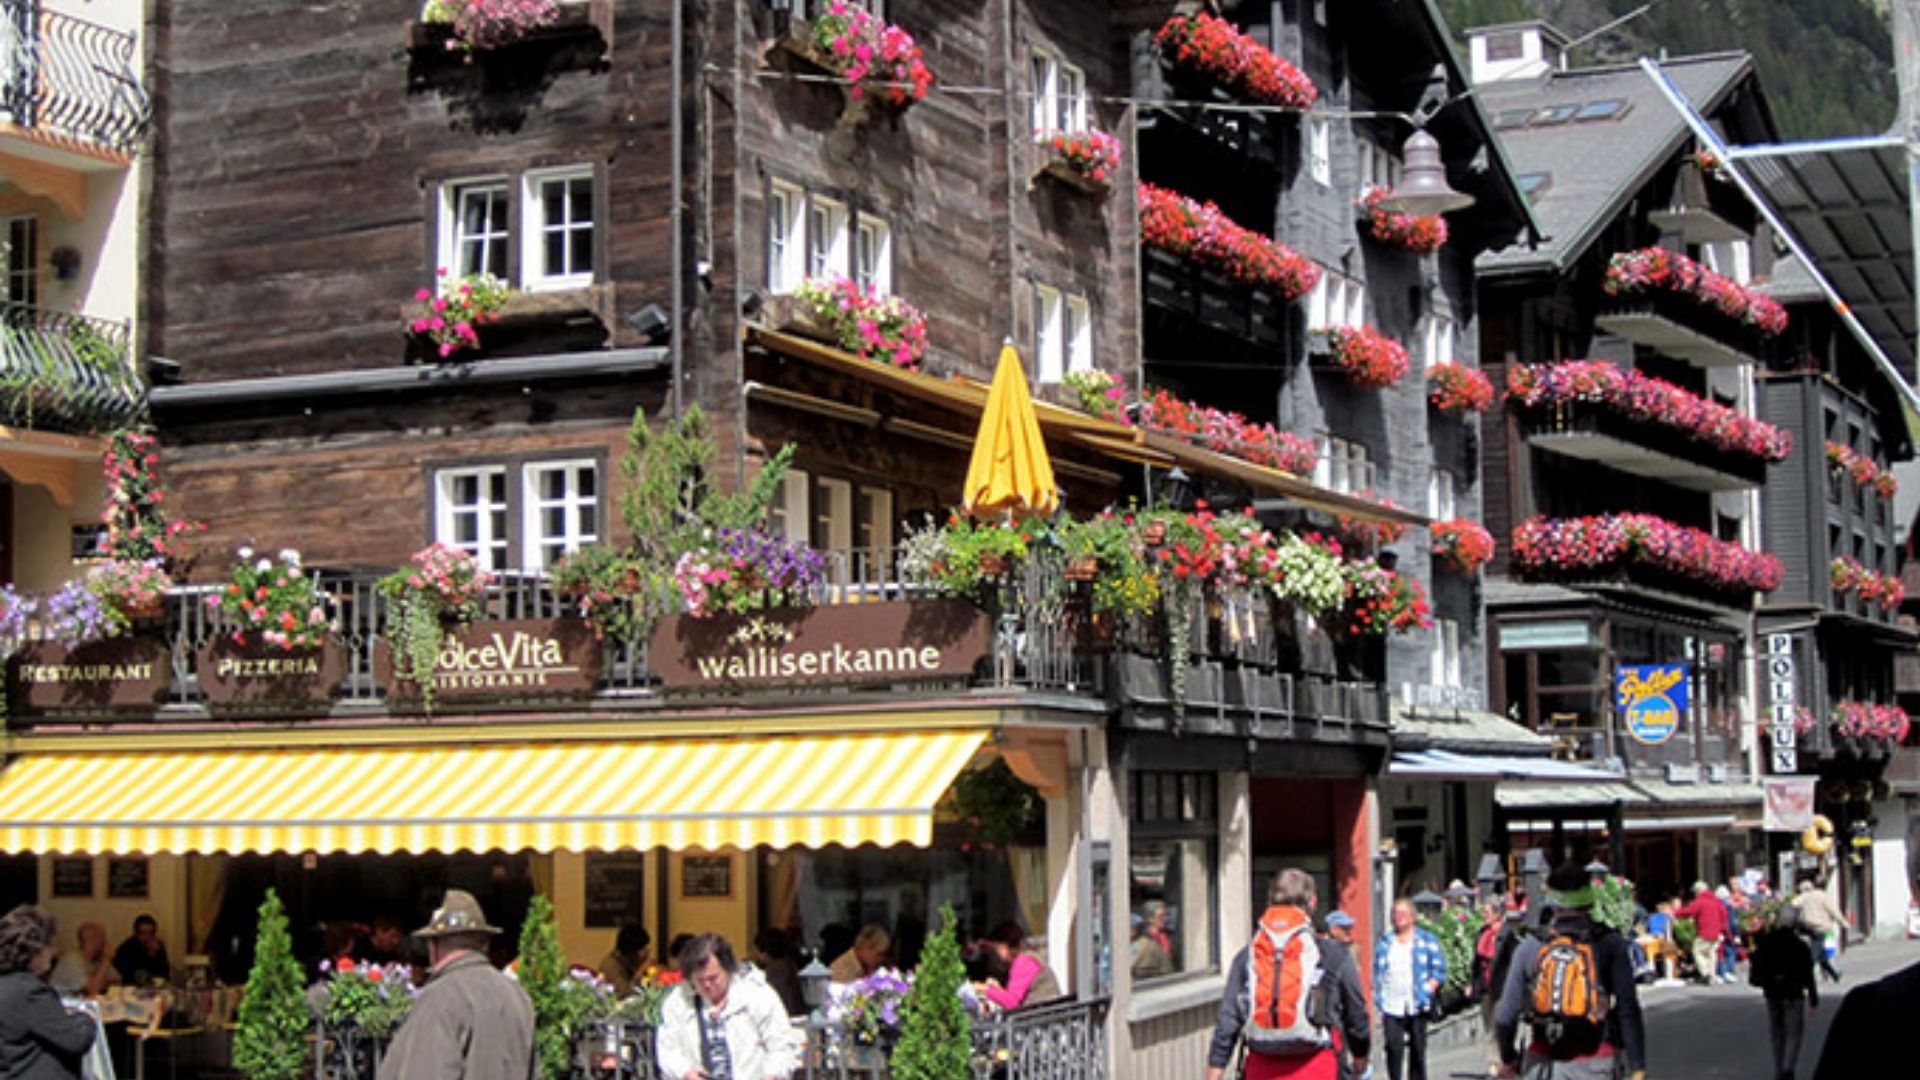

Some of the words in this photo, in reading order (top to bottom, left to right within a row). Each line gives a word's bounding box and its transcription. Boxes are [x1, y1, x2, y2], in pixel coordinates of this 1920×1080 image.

[218, 658, 319, 676] PIZZERIA
[434, 631, 562, 671] olceVita
[697, 643, 940, 679] walliserkanne
[19, 664, 151, 682] RESTAURANT
[1772, 635, 1793, 769] POLLUX
